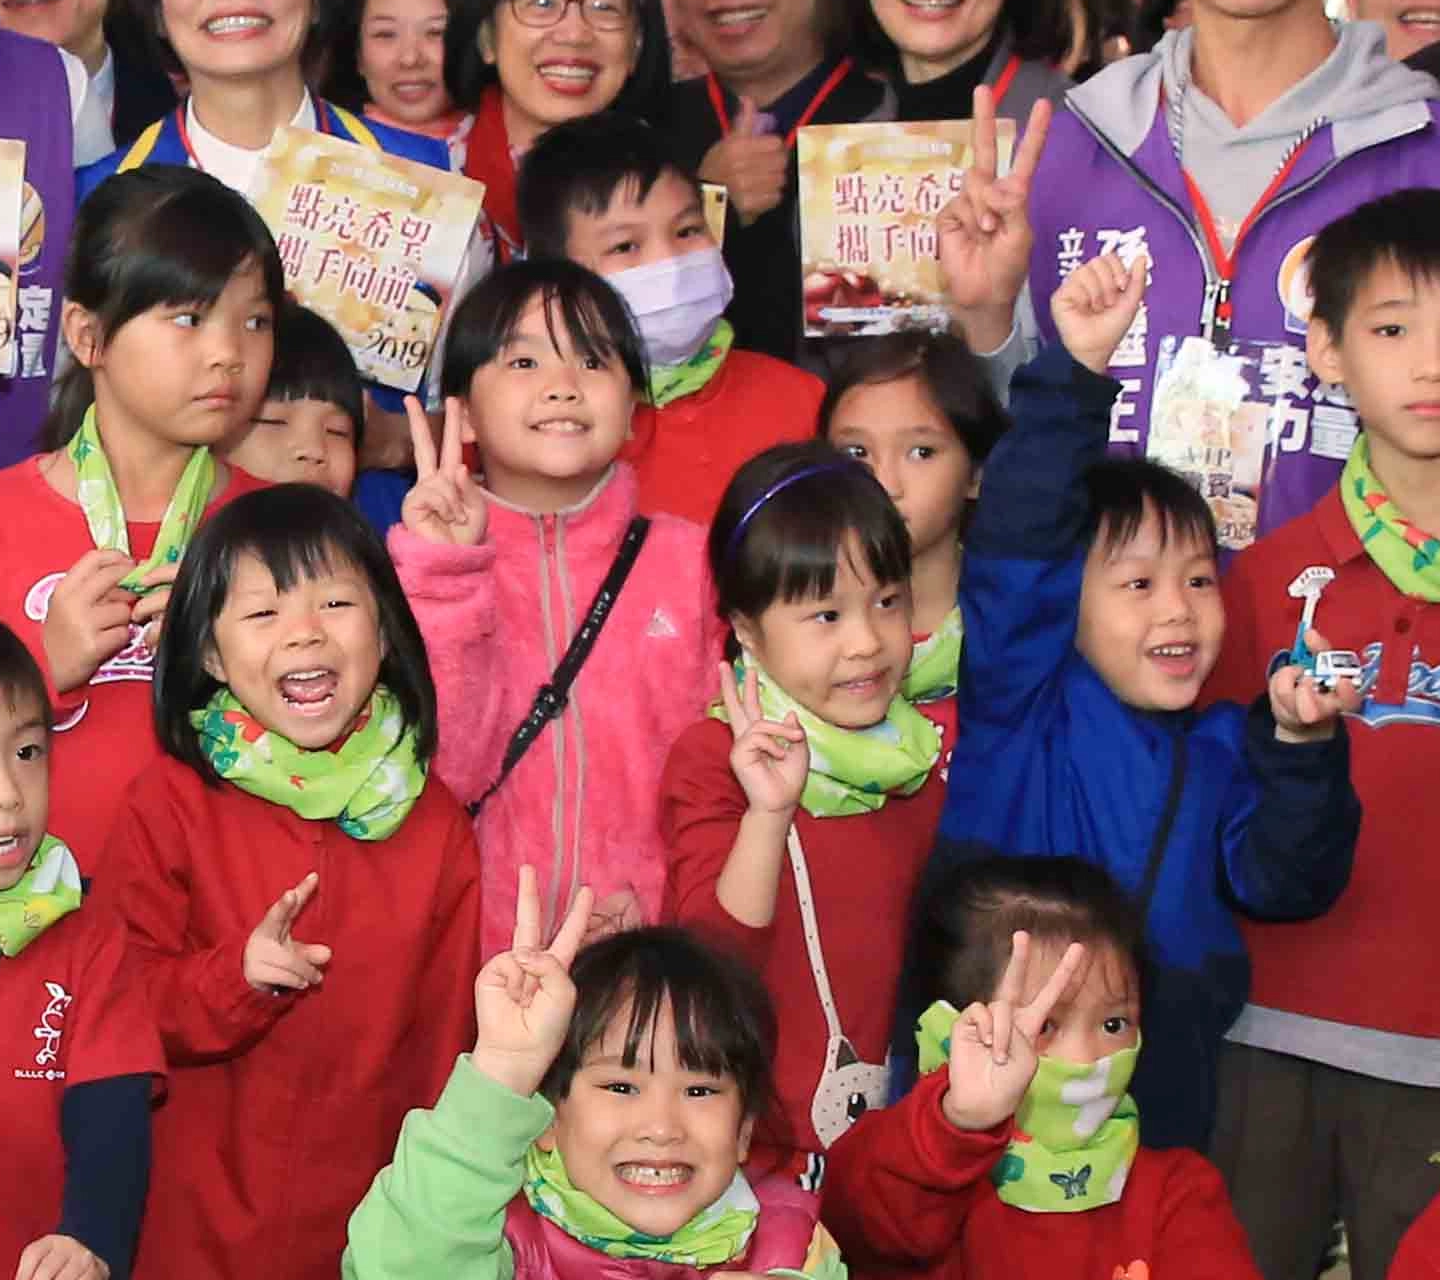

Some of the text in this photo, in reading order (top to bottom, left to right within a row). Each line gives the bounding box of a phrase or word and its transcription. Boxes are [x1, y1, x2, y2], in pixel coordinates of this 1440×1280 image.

[285, 183, 432, 261] 點亮希望
[834, 223, 941, 262] 攜手向
[367, 328, 428, 369] 2019
